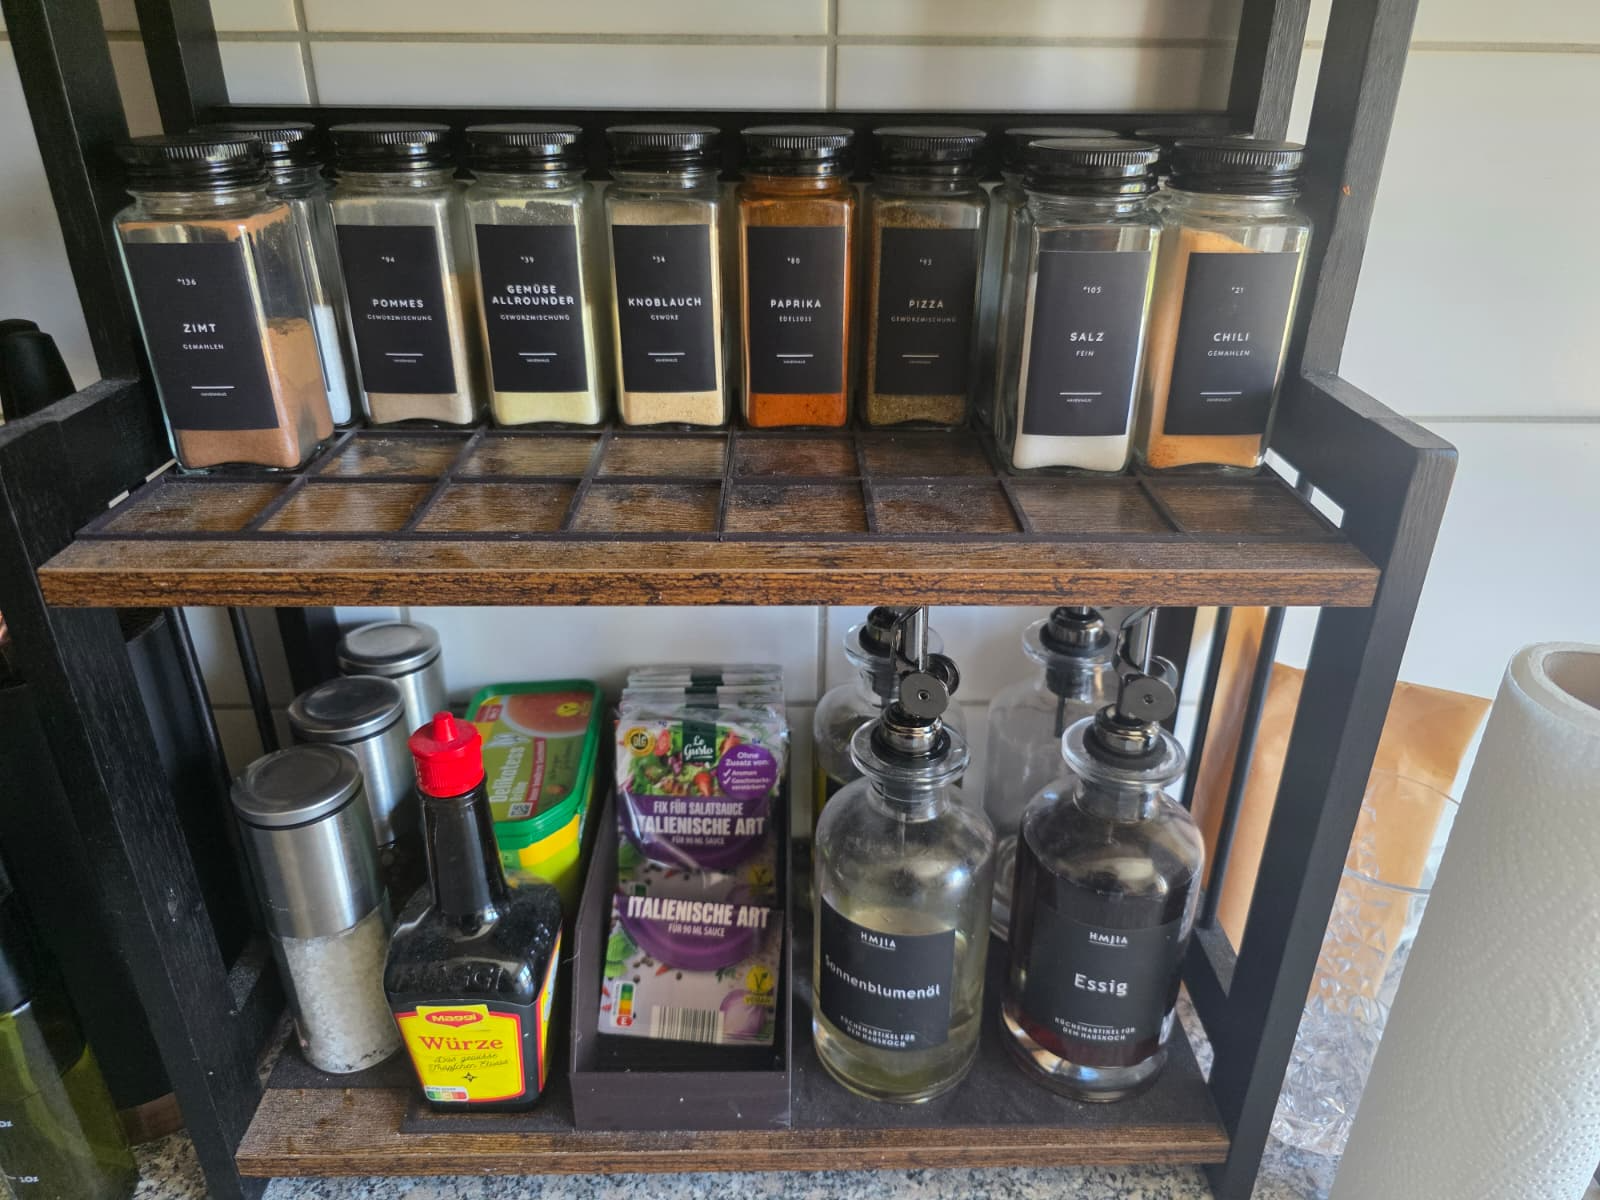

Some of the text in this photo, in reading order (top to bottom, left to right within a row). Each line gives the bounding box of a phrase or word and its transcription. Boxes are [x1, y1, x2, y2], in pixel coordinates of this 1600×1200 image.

[506, 283, 557, 295] GEMÜSE
[372, 298, 425, 309] POMMES
[492, 296, 575, 306] ALLROUNDER
[628, 297, 702, 307] KNOBLAUCH
[770, 299, 822, 309] PAPRIKA
[908, 299, 945, 309] PIZZA
[183, 323, 217, 334] ZIMT
[1070, 332, 1105, 342] SALZ
[1213, 332, 1250, 342] CHILI
[182, 343, 225, 351] GEMAHLEN
[1207, 349, 1251, 357] GEMAHLEN
[692, 735, 704, 747] Le
[683, 745, 714, 760] Gusto
[653, 798, 744, 816] FIX FÜR SALATSAUCE
[735, 817, 765, 837] ART
[627, 896, 771, 929] ITALIENISCHE ART
[668, 922, 726, 937] FÜR 90 ML SAUCE
[860, 931, 897, 949] HMJIA
[1089, 931, 1129, 945] HMJIA
[825, 954, 941, 1000] Sonnenblumenöl
[1074, 972, 1129, 997] Essig
[418, 1035, 504, 1051] Würze
